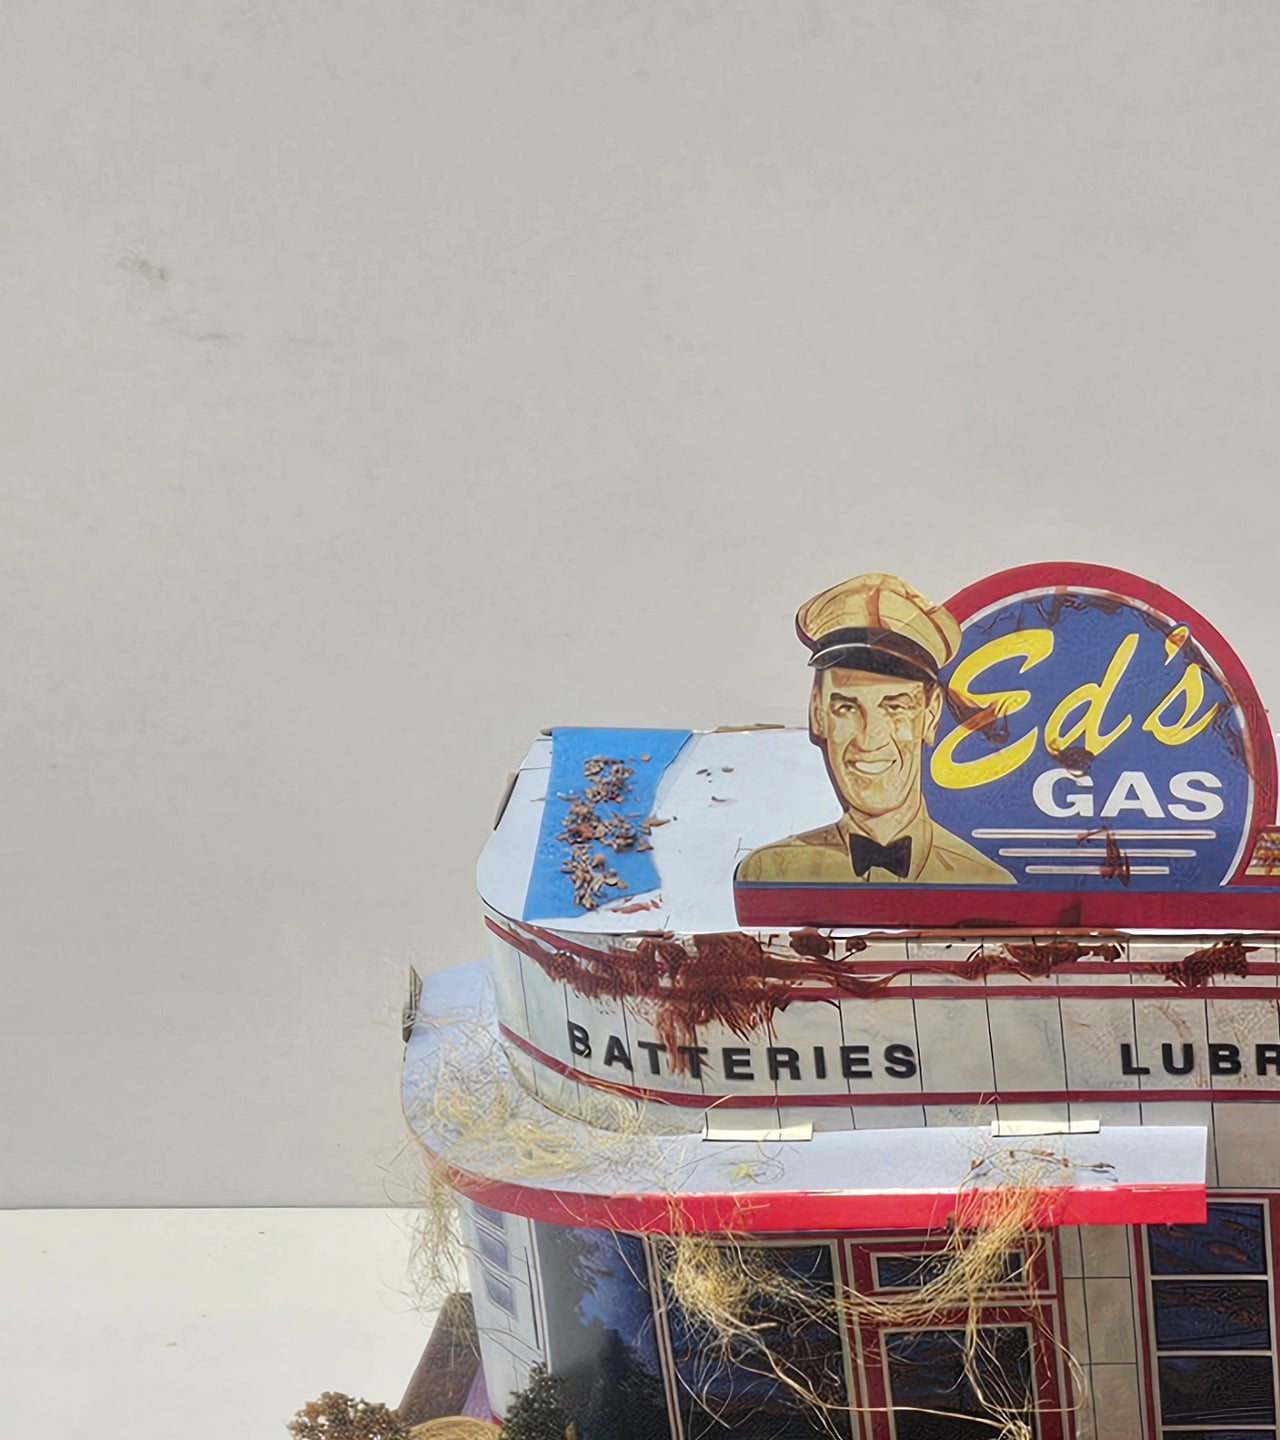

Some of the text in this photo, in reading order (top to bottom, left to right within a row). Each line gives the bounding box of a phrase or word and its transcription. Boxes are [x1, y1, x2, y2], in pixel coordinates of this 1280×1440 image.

[930, 623, 1219, 789] Ed's
[1032, 768, 1224, 820] GAS
[567, 1020, 917, 1079] BATTERIES
